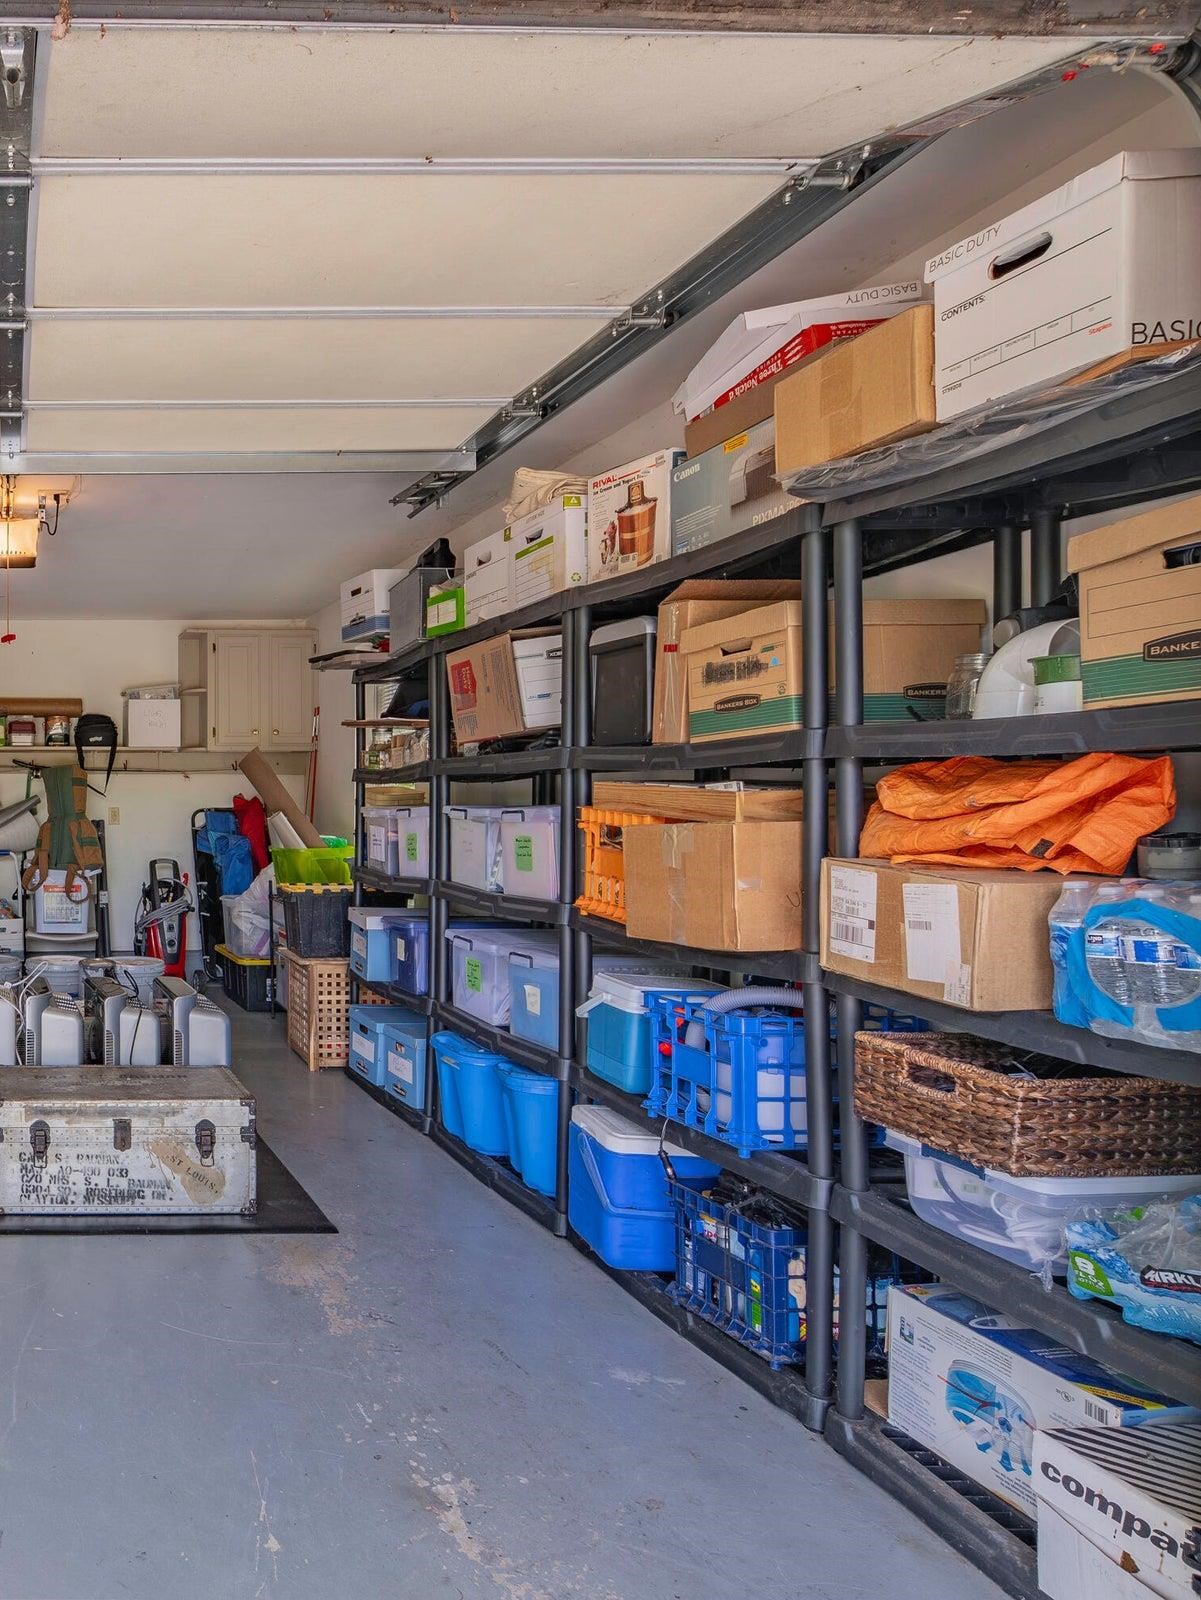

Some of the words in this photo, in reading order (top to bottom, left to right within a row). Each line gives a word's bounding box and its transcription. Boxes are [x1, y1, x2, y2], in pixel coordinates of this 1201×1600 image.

[928, 245, 964, 273] BASIC
[966, 224, 1001, 253] DUTY
[845, 288, 880, 304] DUTY
[881, 282, 918, 298] BASIC
[1088, 322, 1112, 336] Staples
[758, 359, 783, 381] Three
[673, 463, 700, 482] Canon
[592, 475, 618, 489] RIVAL
[752, 505, 784, 526] PIXMA
[1150, 641, 1201, 655] BANKE
[716, 701, 743, 711] BANKERS
[744, 698, 758, 706] BOX
[1074, 1256, 1095, 1276] 8
